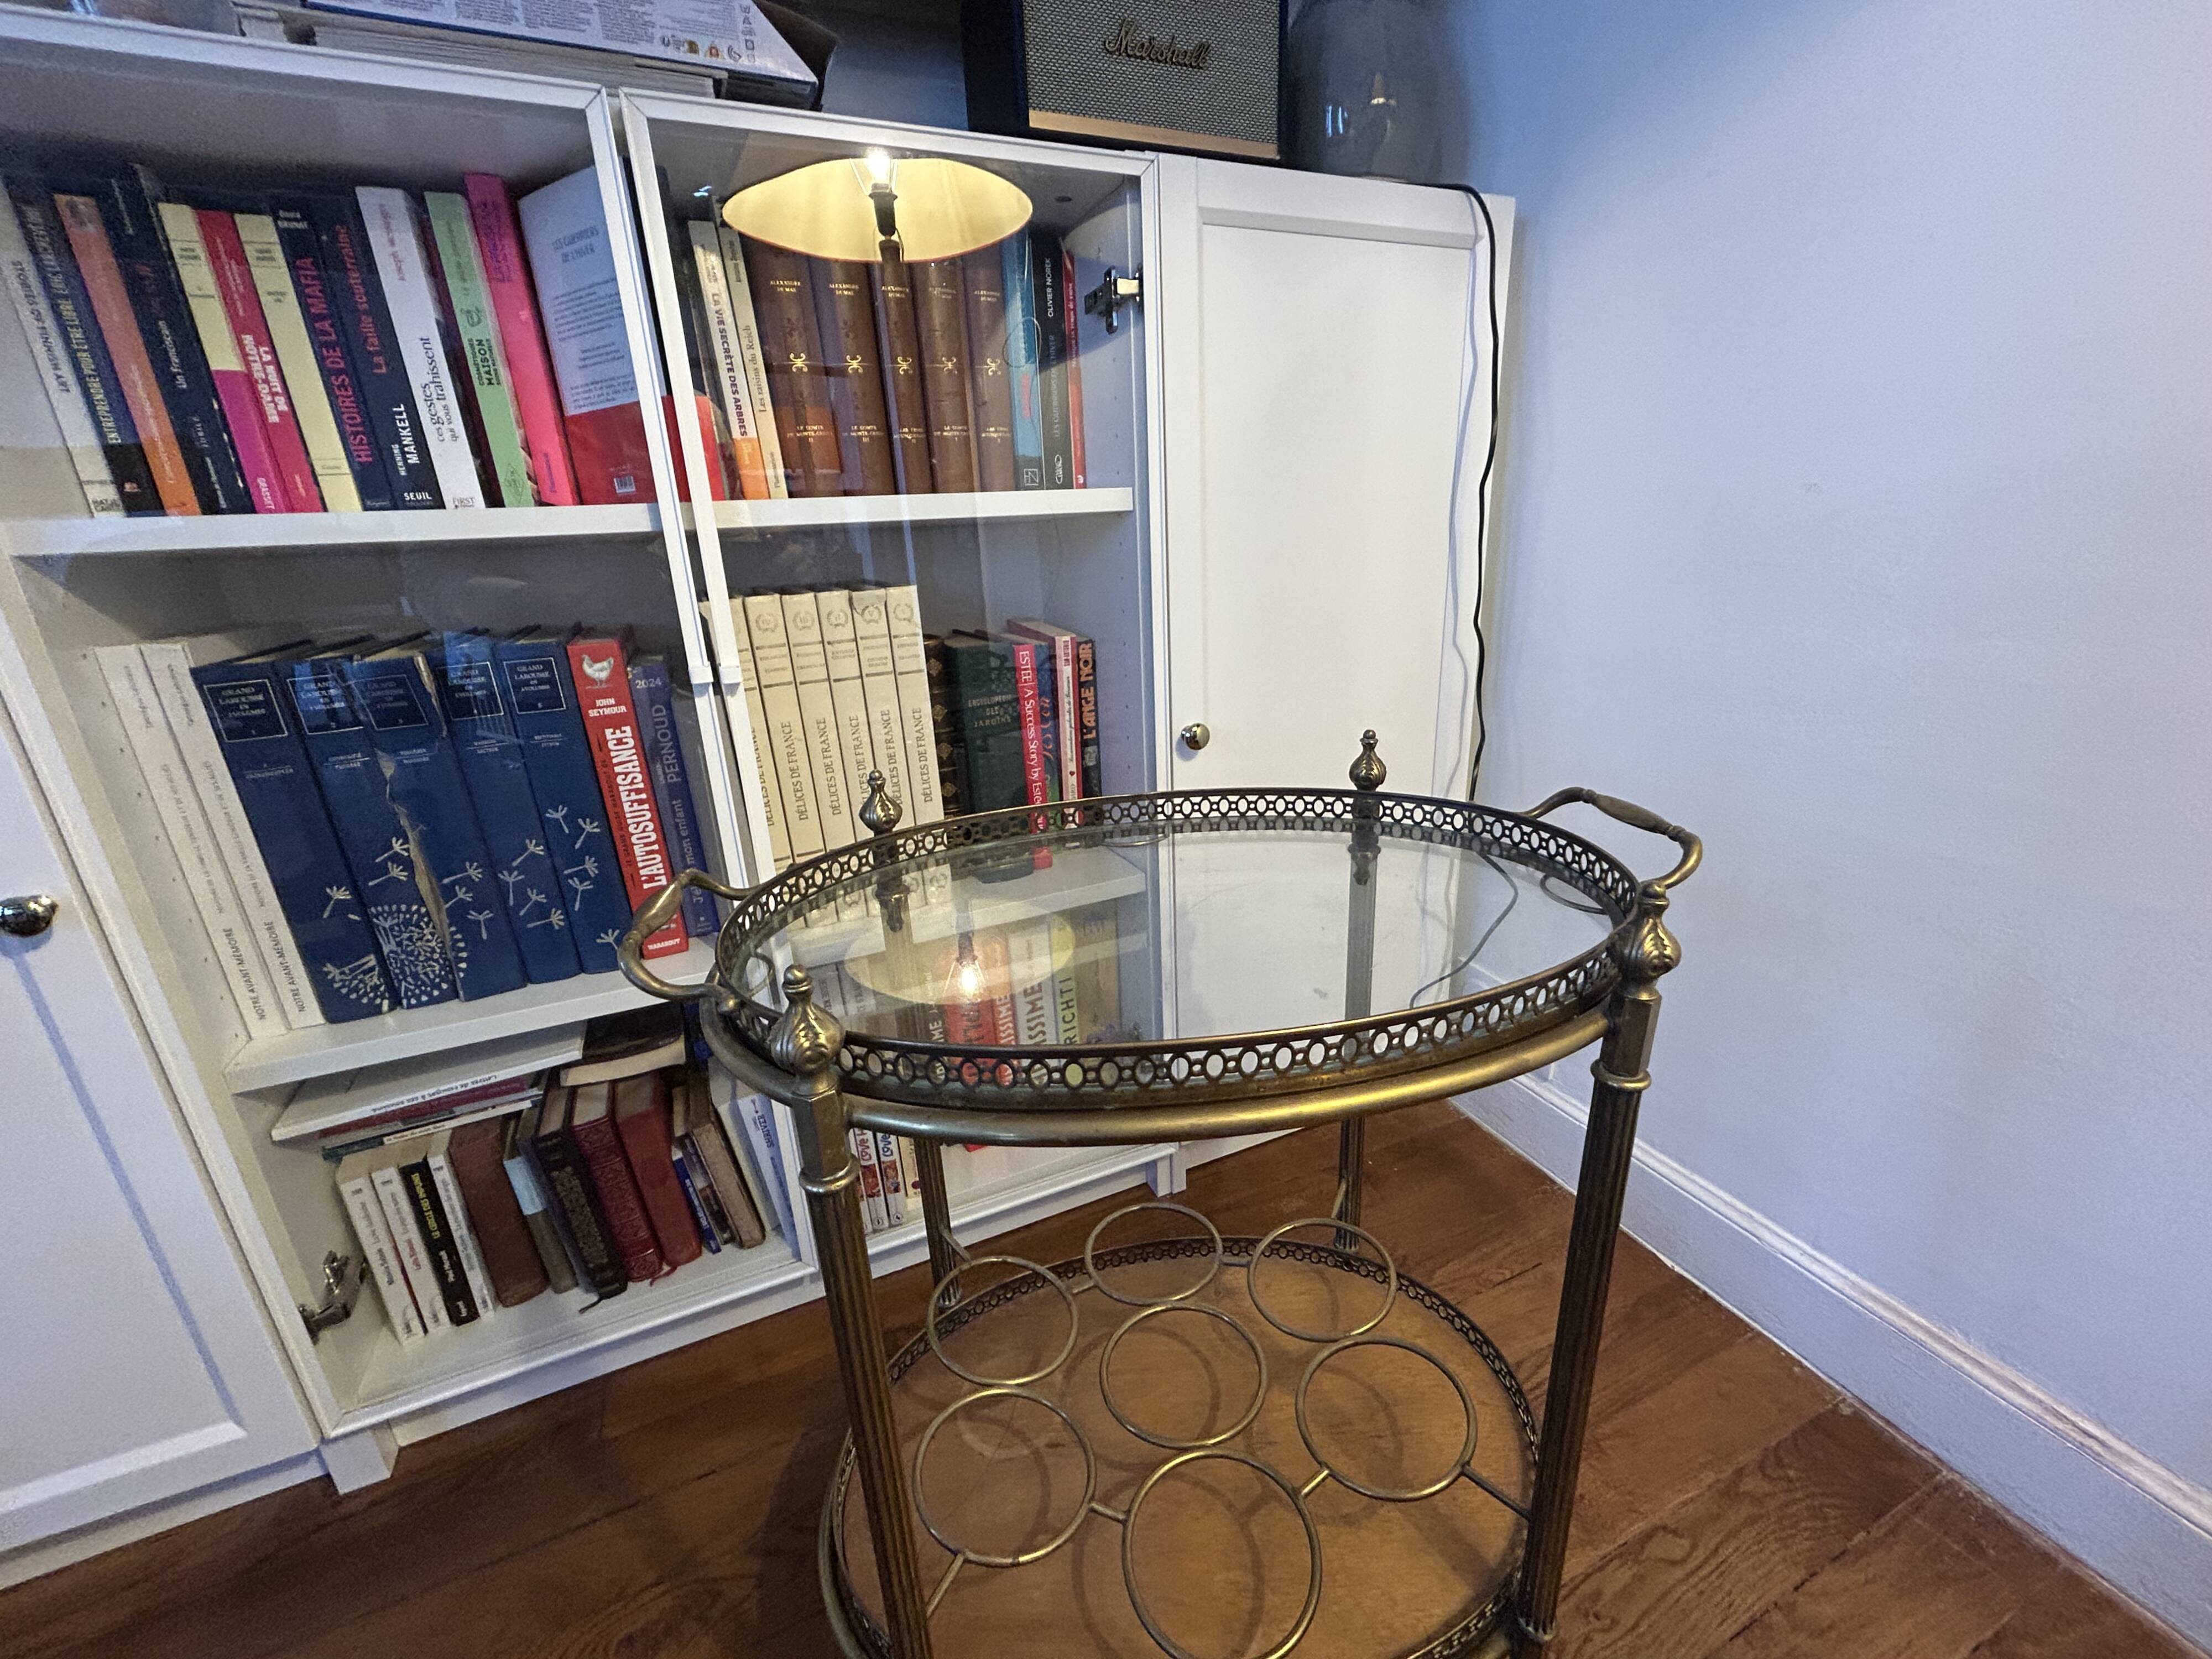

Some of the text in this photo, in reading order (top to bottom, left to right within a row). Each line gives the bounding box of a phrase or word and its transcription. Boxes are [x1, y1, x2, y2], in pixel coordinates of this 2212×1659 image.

[1105, 18, 1211, 68] Marshall
[295, 257, 329, 315] MAFIA
[1045, 258, 1053, 286] NOREK
[335, 223, 387, 373] La faille souterraine
[711, 292, 720, 306] LA
[317, 319, 337, 343] LA
[714, 309, 725, 327] VIE
[259, 347, 271, 361] LA
[326, 346, 346, 370] DE
[476, 339, 494, 385] MAISON
[717, 325, 737, 374] SECRÈTE
[741, 322, 766, 413] Les raisins du Reich
[242, 335, 279, 424] NOTRE-DAME
[419, 336, 459, 442] qui vous trahissent
[728, 374, 739, 395] DES
[85, 375, 121, 444] ENTREPRENDRE
[330, 373, 373, 463] HISTOIRES
[422, 383, 445, 442] ces gestes
[732, 395, 748, 438] ARBRES
[392, 404, 420, 463] MANKELL
[392, 444, 407, 476] HENNING
[404, 492, 432, 500] SEUIL
[636, 677, 662, 688] 2024
[1024, 689, 1034, 697] A
[1079, 643, 1097, 739] L'ANGE NOIR
[588, 706, 627, 717] SEYMOUR
[596, 698, 615, 707] JOHN
[1025, 699, 1036, 739] Success
[652, 705, 682, 782] PERNOUD
[849, 715, 864, 756] FRANCE
[880, 710, 895, 750] FRANCE
[781, 722, 808, 821] DÉLICES DE FRANCE
[816, 718, 841, 816] DÉLICES DE FRANCE
[857, 757, 867, 771] DE
[887, 752, 897, 764] DE
[912, 707, 932, 802] DÉLICES DE FRANCE
[1027, 740, 1039, 766] Story
[1030, 768, 1041, 780] by
[604, 726, 667, 889] L'AUTOSUFFISANCE
[672, 799, 695, 864] mon enfant
[648, 938, 681, 950] MARABOUT
[249, 994, 267, 1021] NOTRE
[290, 987, 306, 1013] NOTRE
[757, 1114, 774, 1148] SHRIVER
[858, 1138, 872, 1161] Love
[880, 1134, 893, 1157] Love
